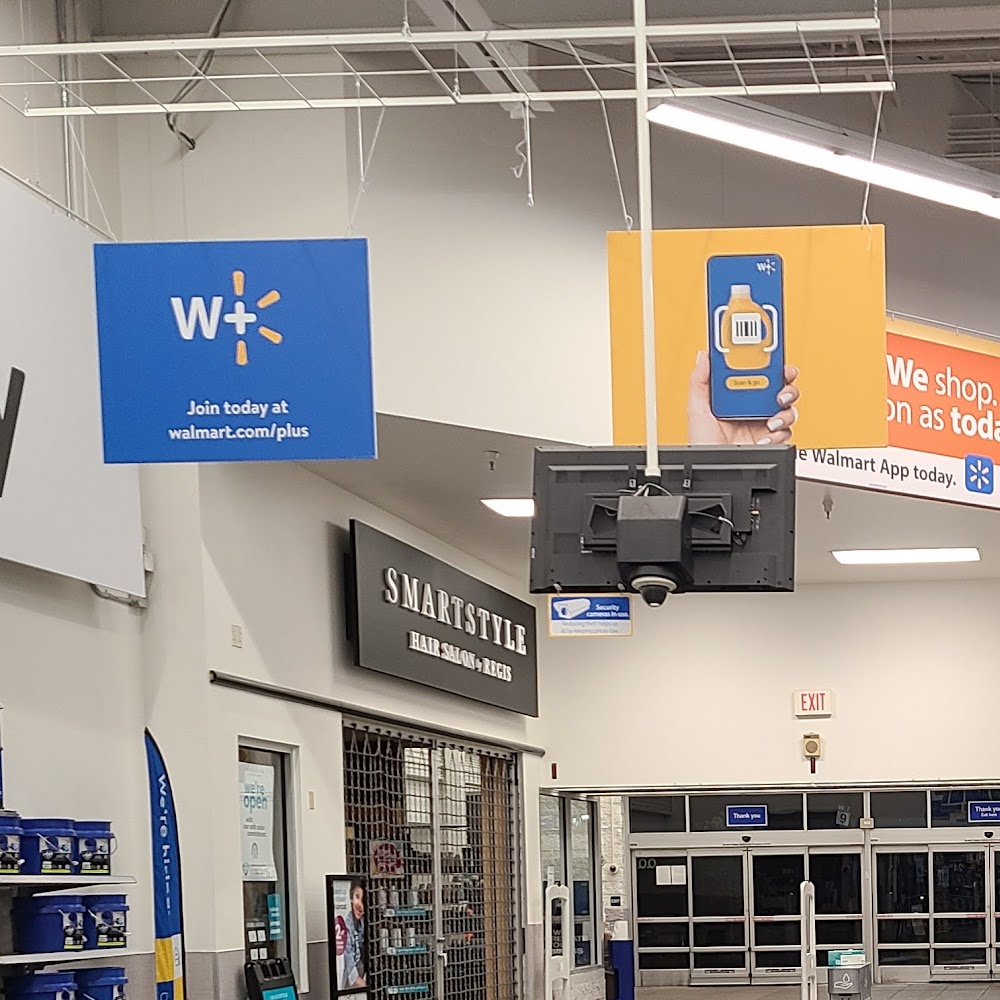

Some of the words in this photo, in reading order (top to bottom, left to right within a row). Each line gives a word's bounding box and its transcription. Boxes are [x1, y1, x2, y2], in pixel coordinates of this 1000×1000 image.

[885, 354, 930, 391] We
[934, 366, 998, 411] shop.
[187, 400, 220, 416] Join
[223, 400, 267, 418] today
[271, 401, 289, 415] at
[919, 405, 946, 431] as
[168, 424, 310, 441] walmart.com/plus
[811, 447, 876, 473] Walmart
[879, 462, 910, 483] App
[913, 465, 957, 486] today.
[383, 567, 528, 656] SMARTSTYLE
[595, 604, 620, 612] Security
[407, 630, 441, 658] HAIR
[440, 641, 476, 670] SALON
[482, 657, 513, 682] REGIS
[801, 692, 826, 712] EXIT
[158, 774, 168, 838] We're
[243, 795, 268, 814] open
[975, 805, 992, 813] Thank
